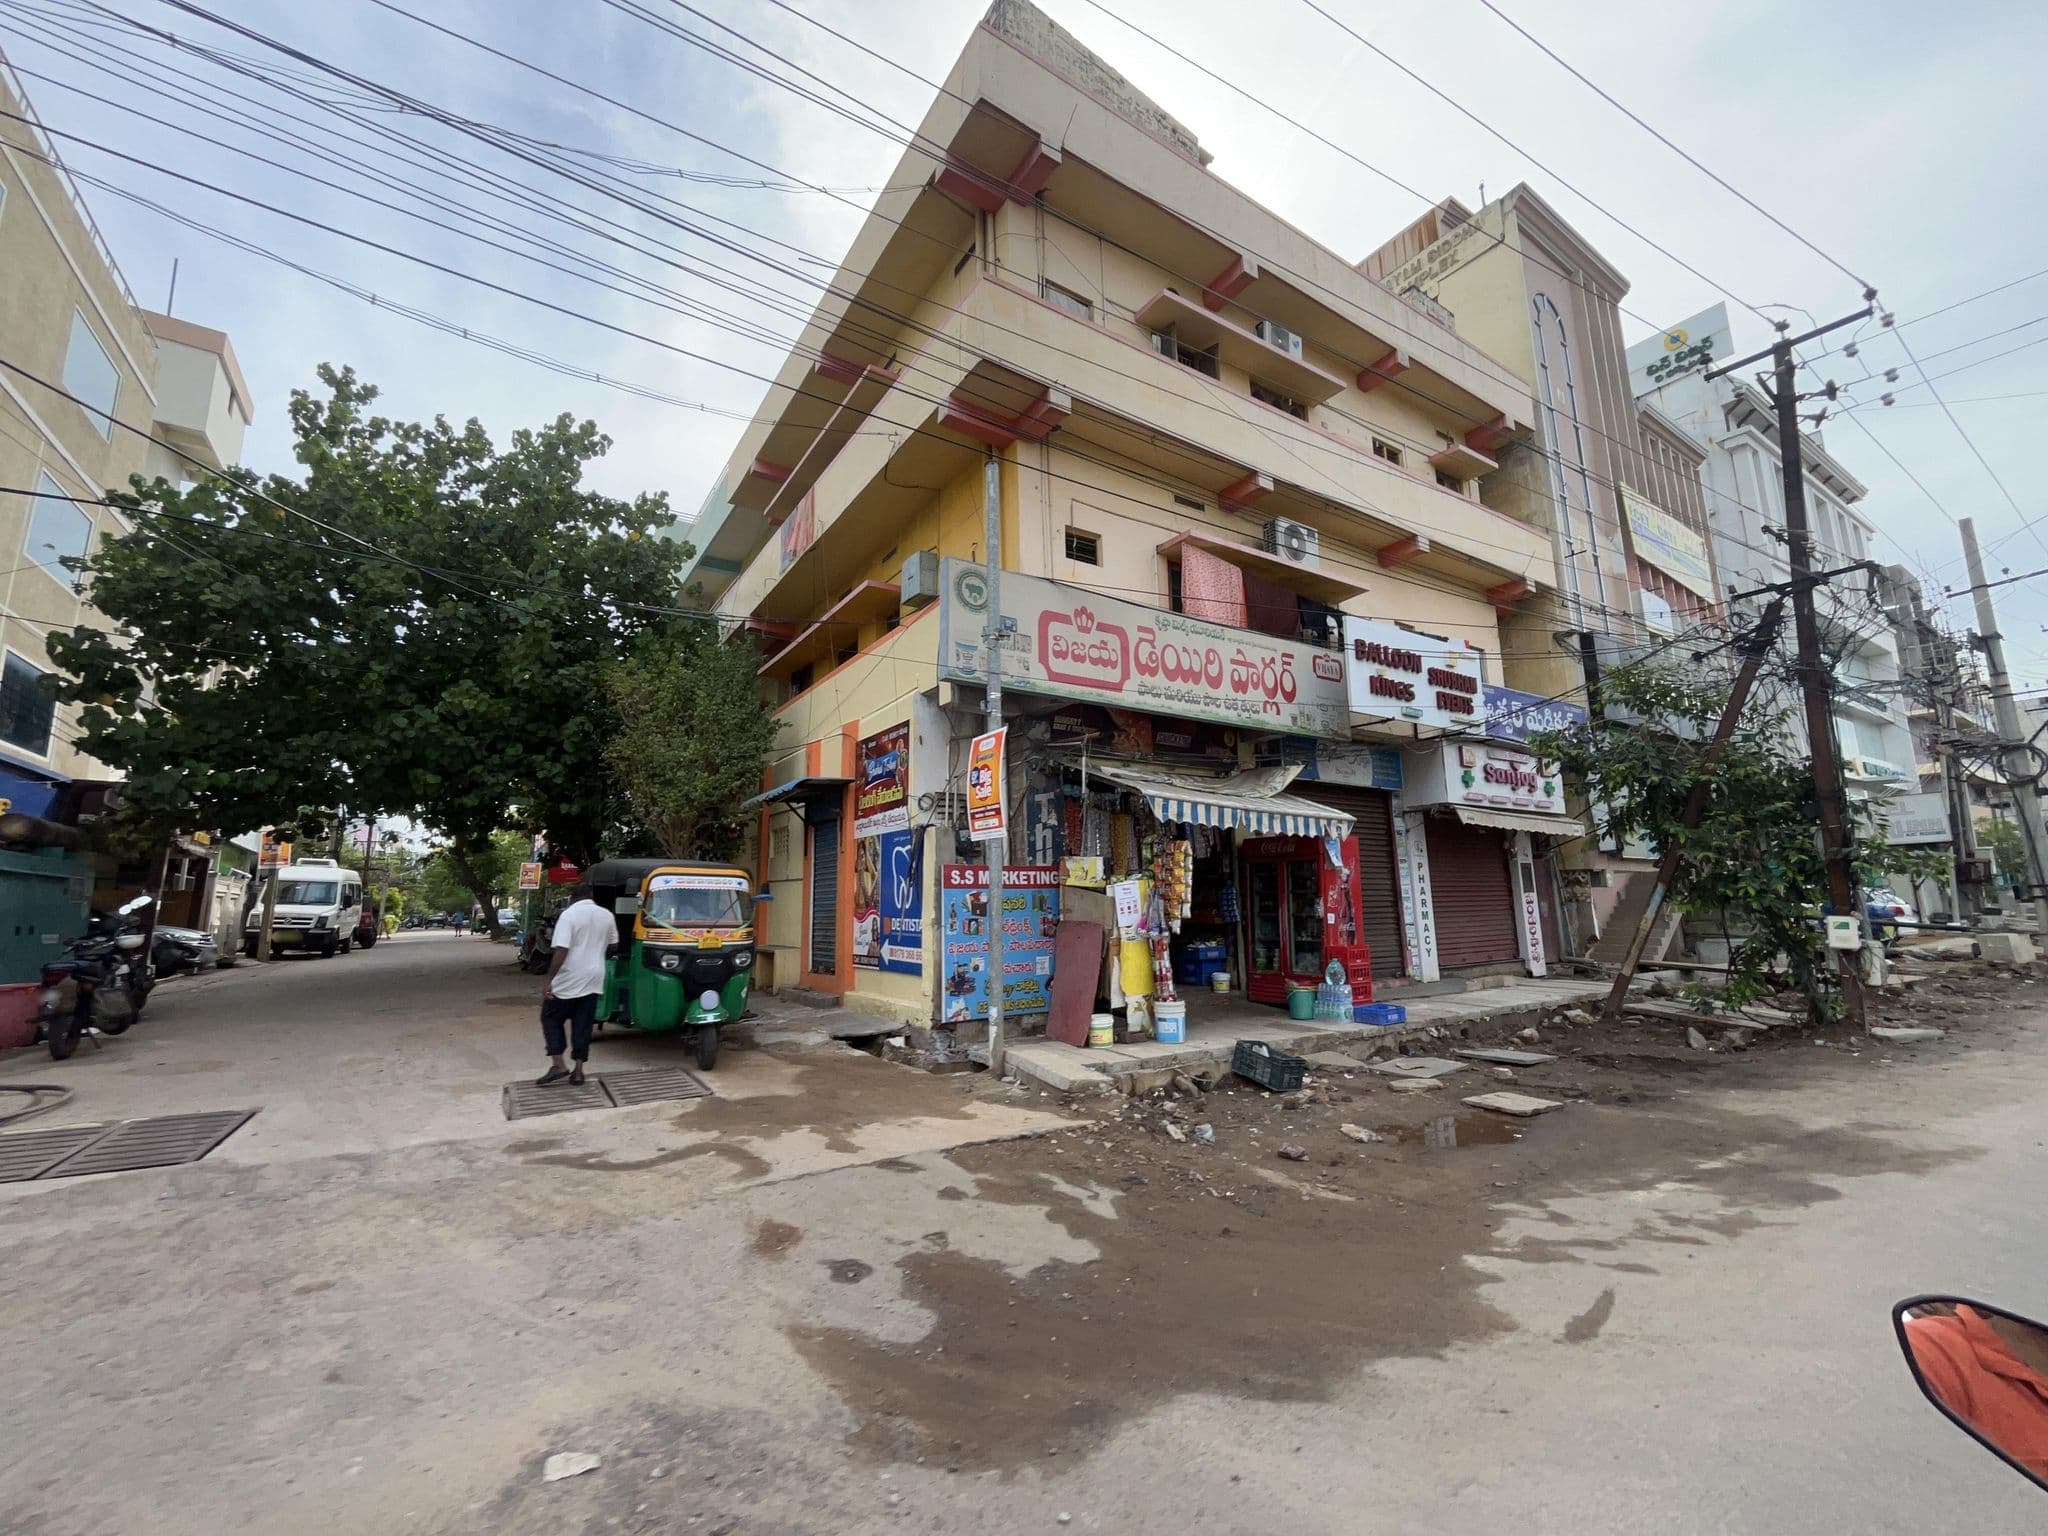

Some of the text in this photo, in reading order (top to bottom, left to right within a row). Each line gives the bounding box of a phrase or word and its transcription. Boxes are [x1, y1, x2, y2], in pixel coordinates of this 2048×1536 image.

[1051, 634, 1119, 670] విజయ
[1354, 638, 1423, 675] BALLOON
[1368, 675, 1416, 703] KINGS
[1435, 690, 1475, 715] EVENTS
[950, 870, 1060, 885] S.S MRKETING
[1417, 862, 1433, 958] PHARMACY
